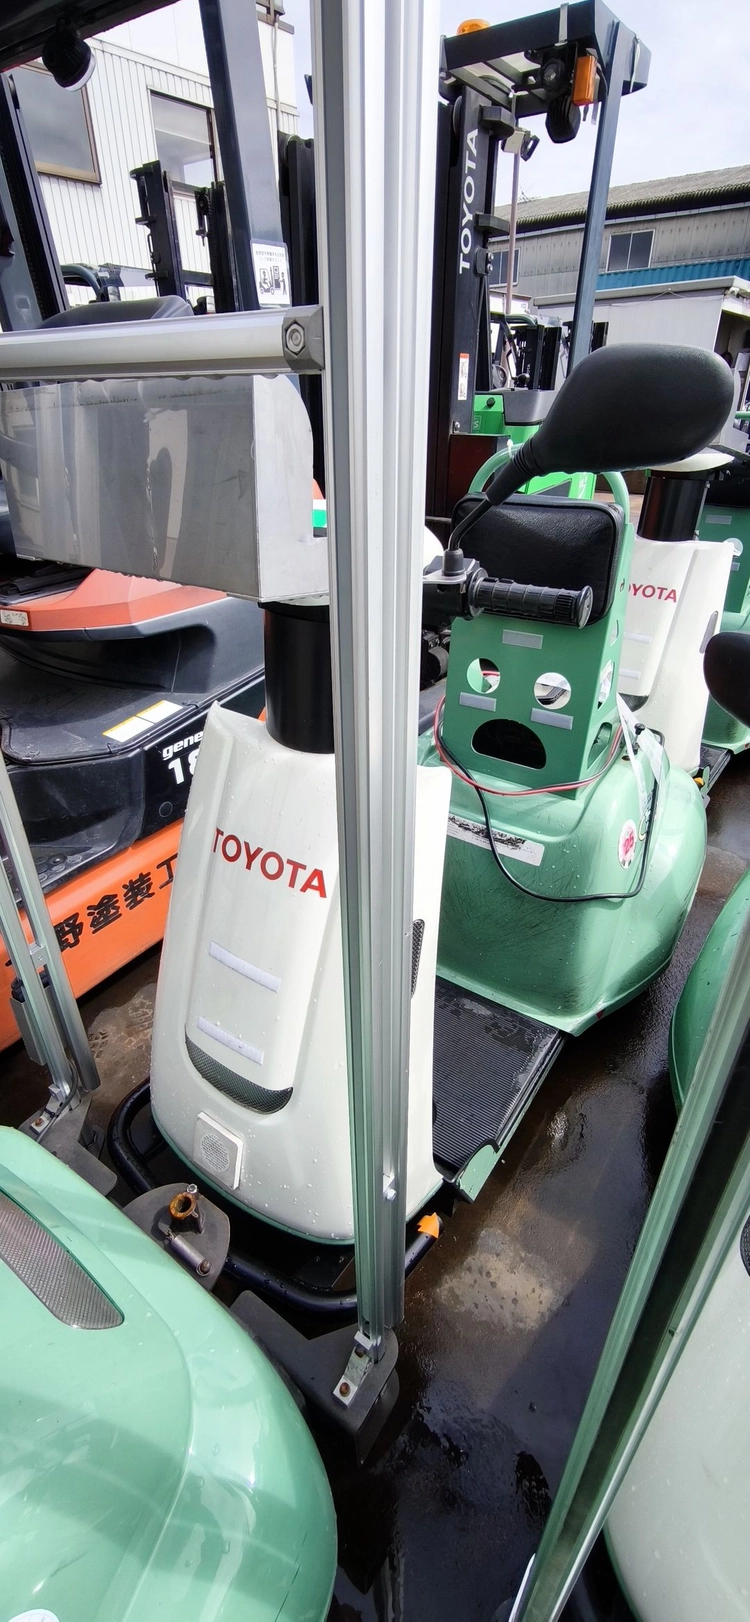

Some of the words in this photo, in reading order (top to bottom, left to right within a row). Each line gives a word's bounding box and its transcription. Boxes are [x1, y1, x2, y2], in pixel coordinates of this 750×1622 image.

[459, 129, 478, 274] TOYOTA
[629, 583, 677, 603] YOTA
[213, 826, 327, 898] TOYOTA
[5, 852, 178, 967] 野塗装工
